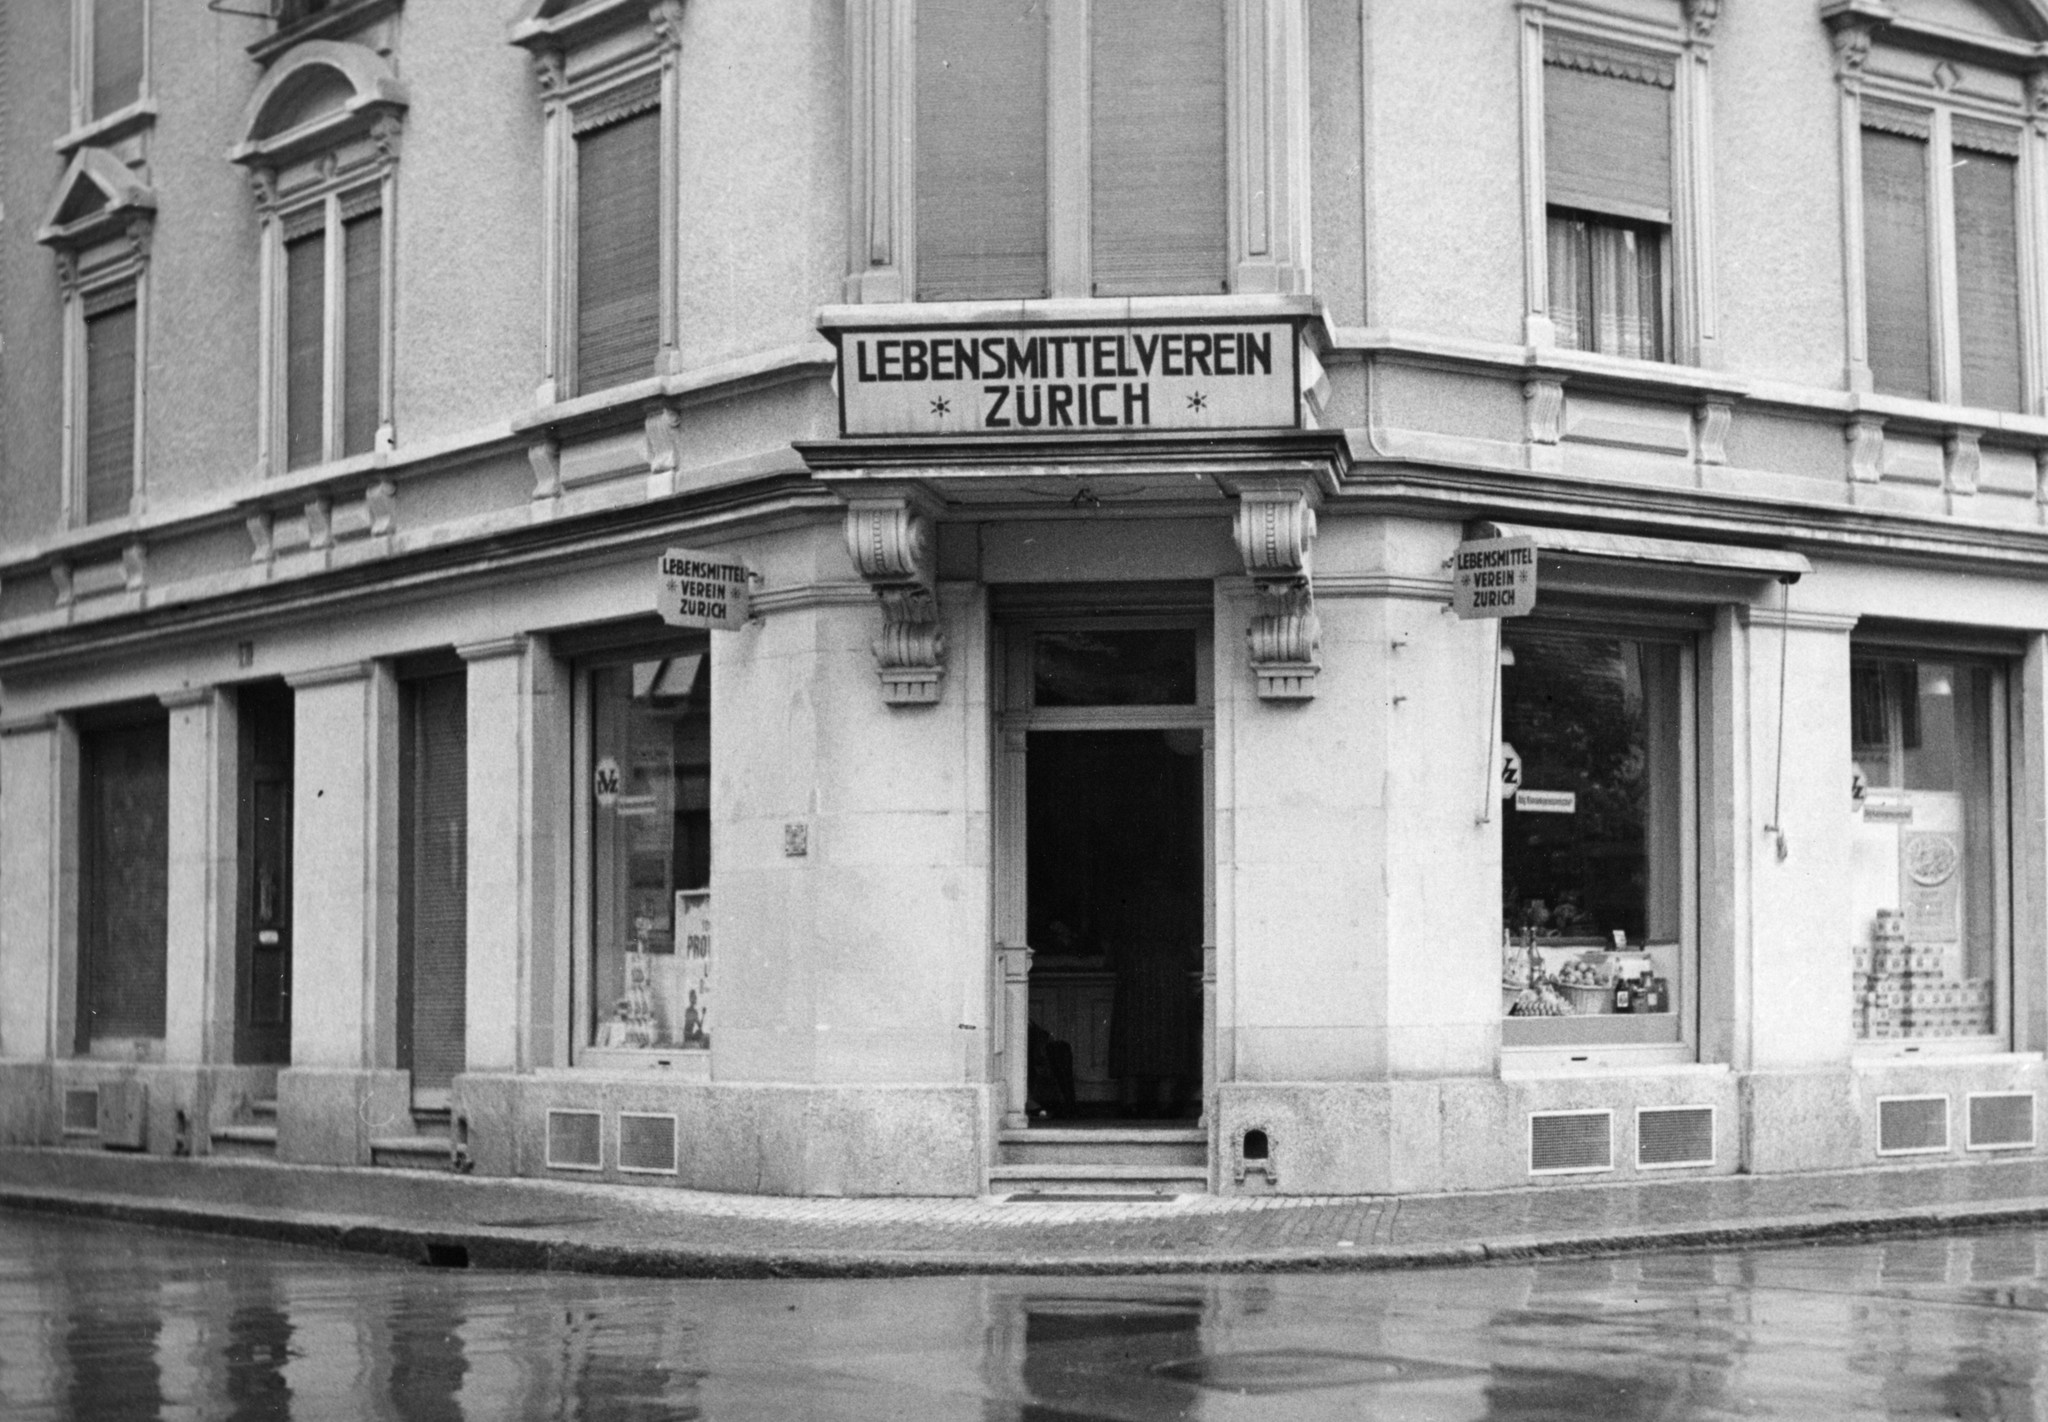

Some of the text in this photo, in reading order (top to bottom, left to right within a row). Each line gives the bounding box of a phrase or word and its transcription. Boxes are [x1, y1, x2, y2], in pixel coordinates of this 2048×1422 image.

[857, 332, 1272, 382] LEBENSMITTELVEREIN
[984, 382, 1149, 427] ZÜRICH
[662, 557, 746, 584] LEBENSMITTEL
[1457, 547, 1533, 571] LEBENSMITTEL
[681, 579, 726, 600] VEREIN
[1473, 570, 1515, 588] VEREIN
